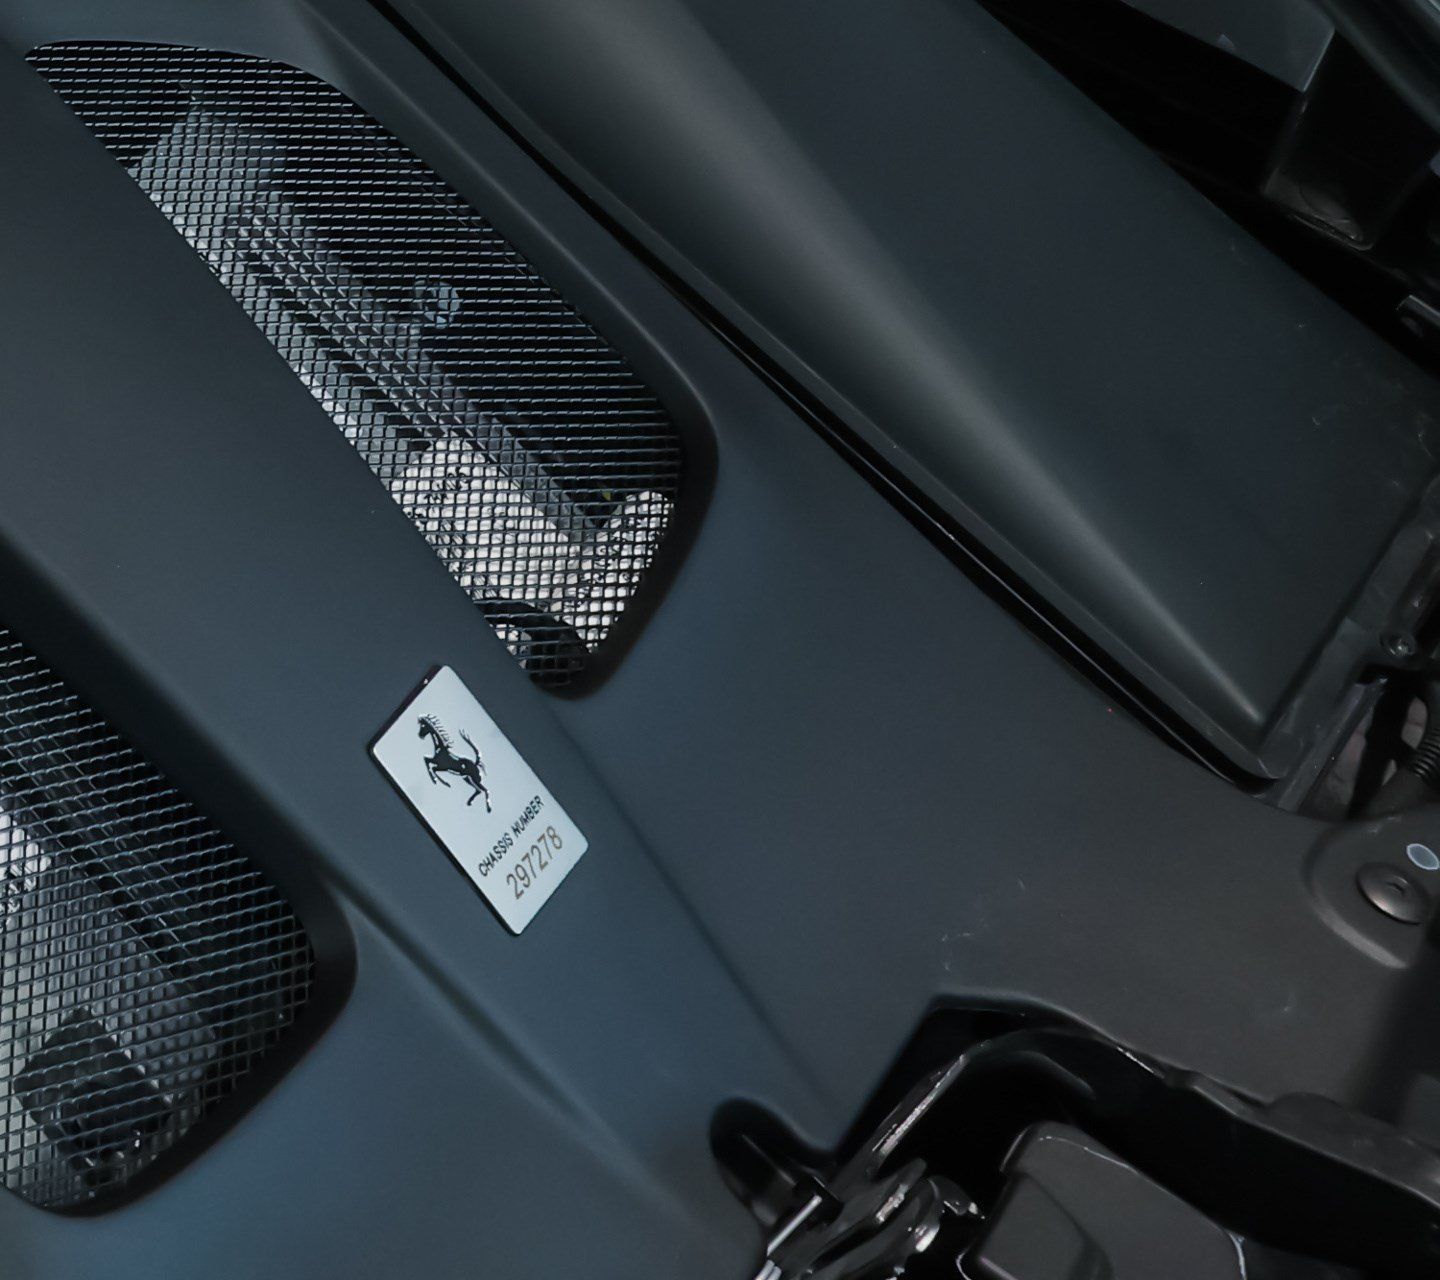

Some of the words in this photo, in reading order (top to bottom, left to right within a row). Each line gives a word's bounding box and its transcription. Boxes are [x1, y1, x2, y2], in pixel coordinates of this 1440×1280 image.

[478, 832, 515, 878] CHASSIS
[511, 795, 545, 838] NUMBER
[506, 825, 564, 900] 297278
